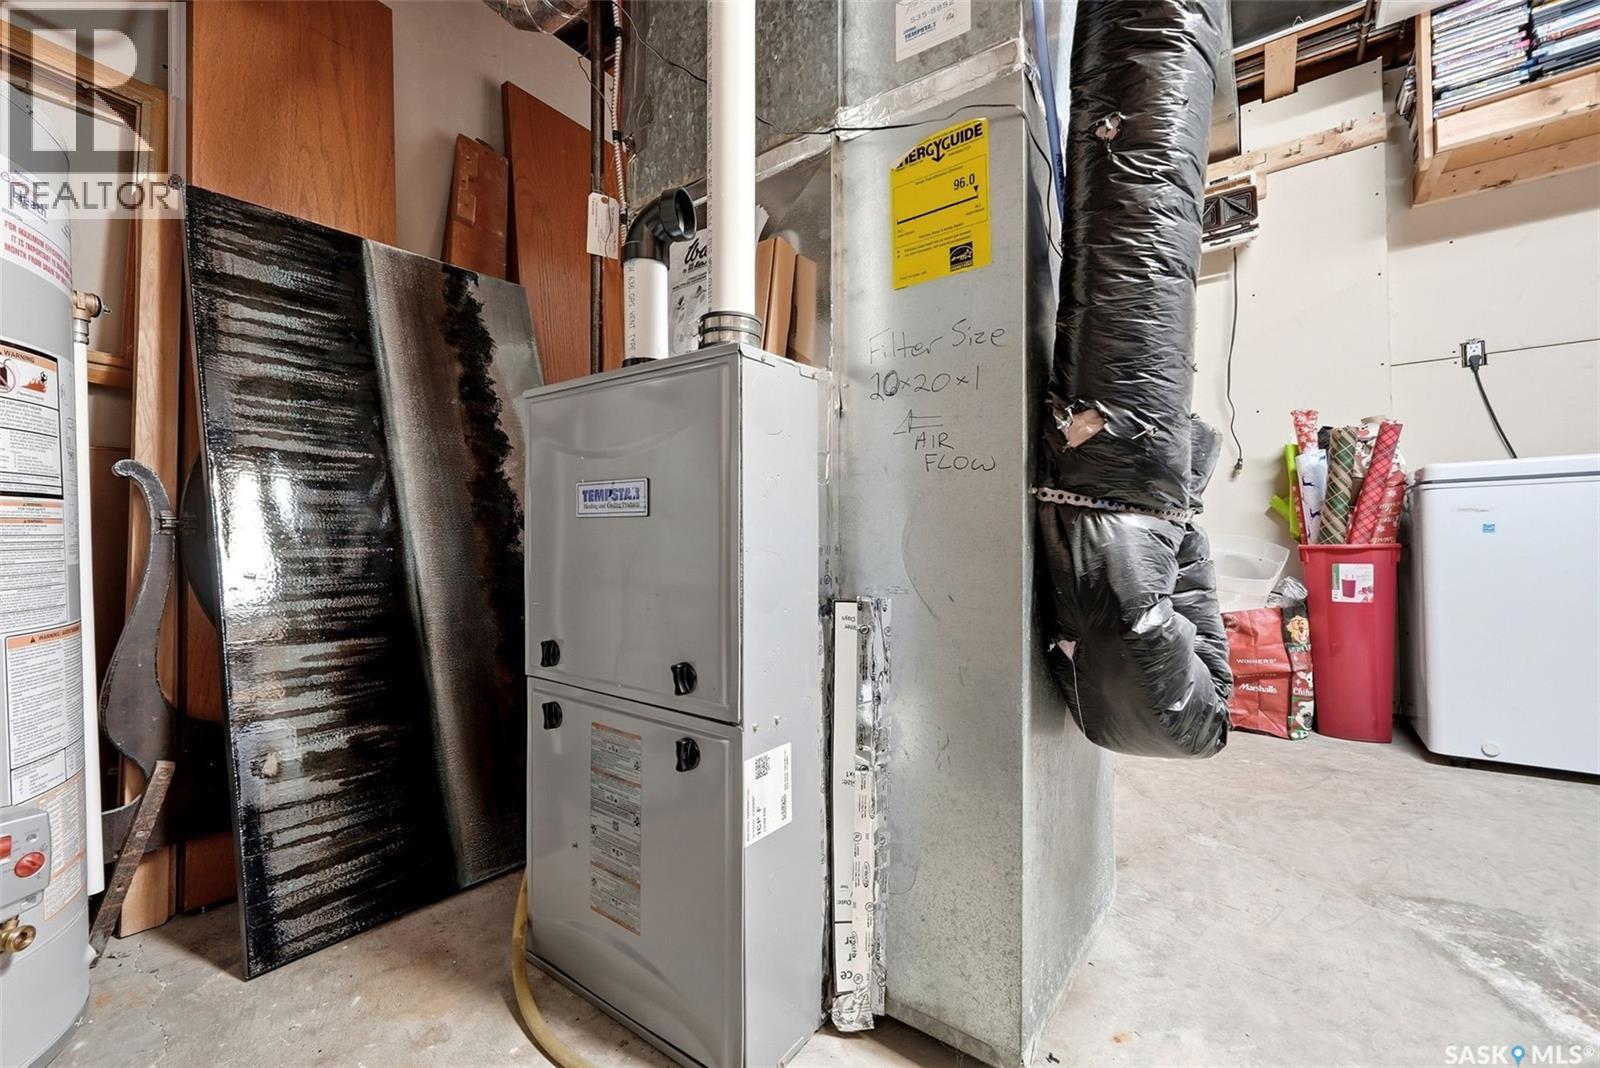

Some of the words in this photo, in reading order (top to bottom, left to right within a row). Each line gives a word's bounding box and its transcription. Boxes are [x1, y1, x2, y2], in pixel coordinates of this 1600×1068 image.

[953, 173, 975, 191] 96.0
[869, 328, 943, 364] Filter
[952, 318, 1009, 348] Size
[4, 349, 35, 364] WARNING
[914, 431, 954, 450] AIR
[925, 453, 996, 472] FLOW
[582, 487, 640, 502] TEMPSTAR
[1238, 682, 1278, 694] Marshalls
